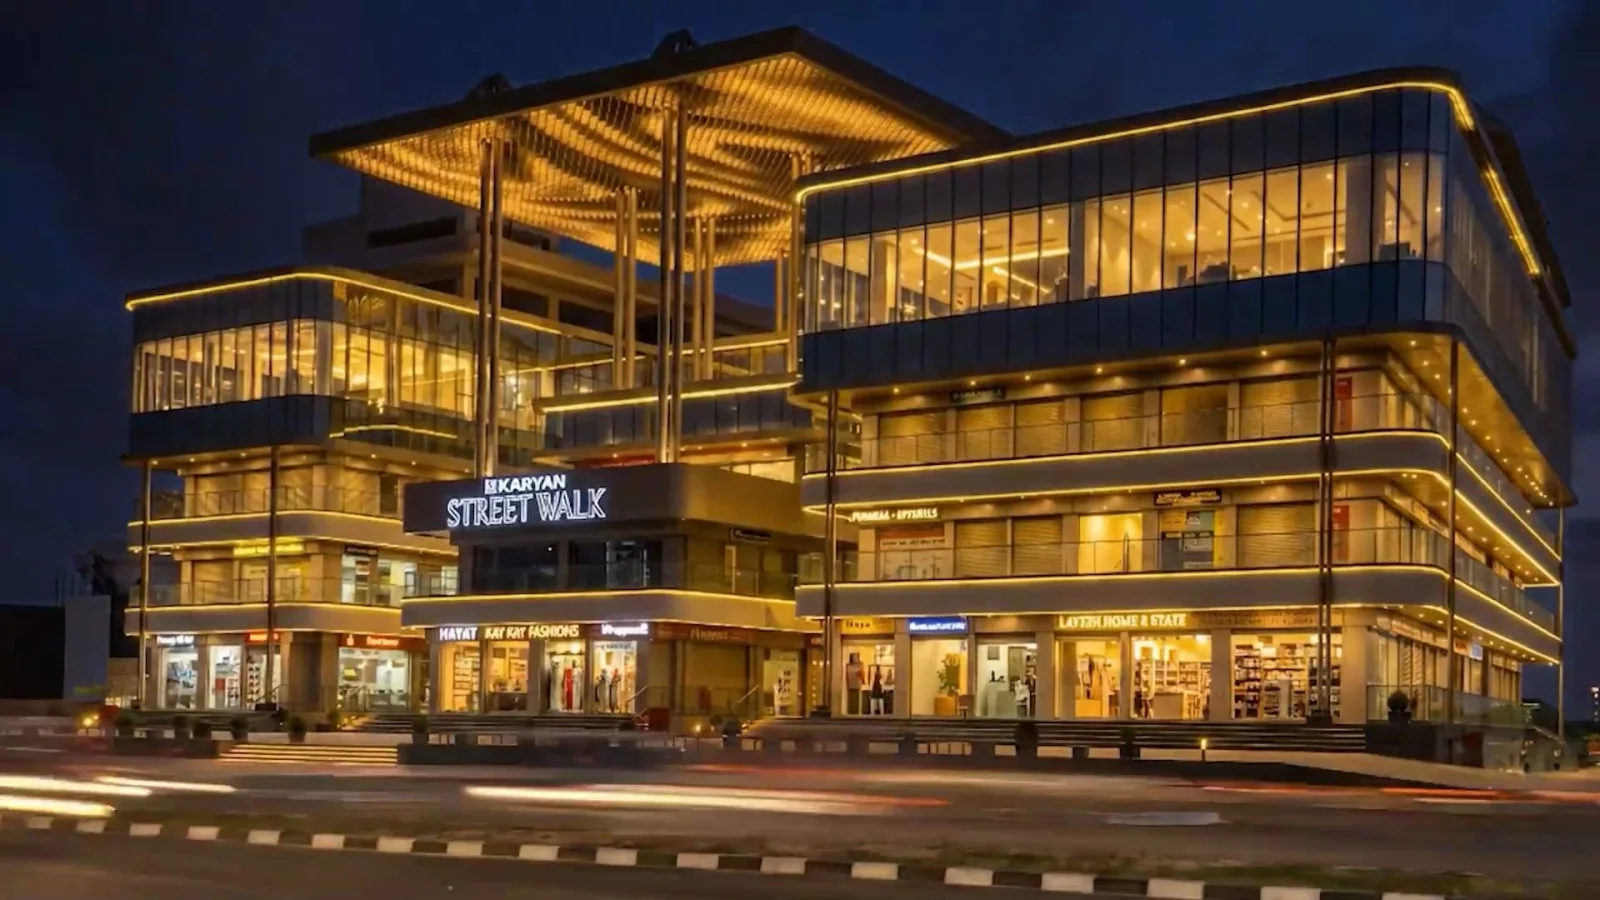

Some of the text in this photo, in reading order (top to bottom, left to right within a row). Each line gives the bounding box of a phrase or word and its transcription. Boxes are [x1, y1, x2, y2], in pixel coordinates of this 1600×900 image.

[498, 475, 566, 493] KARYAN
[447, 488, 606, 527] STREET WALK
